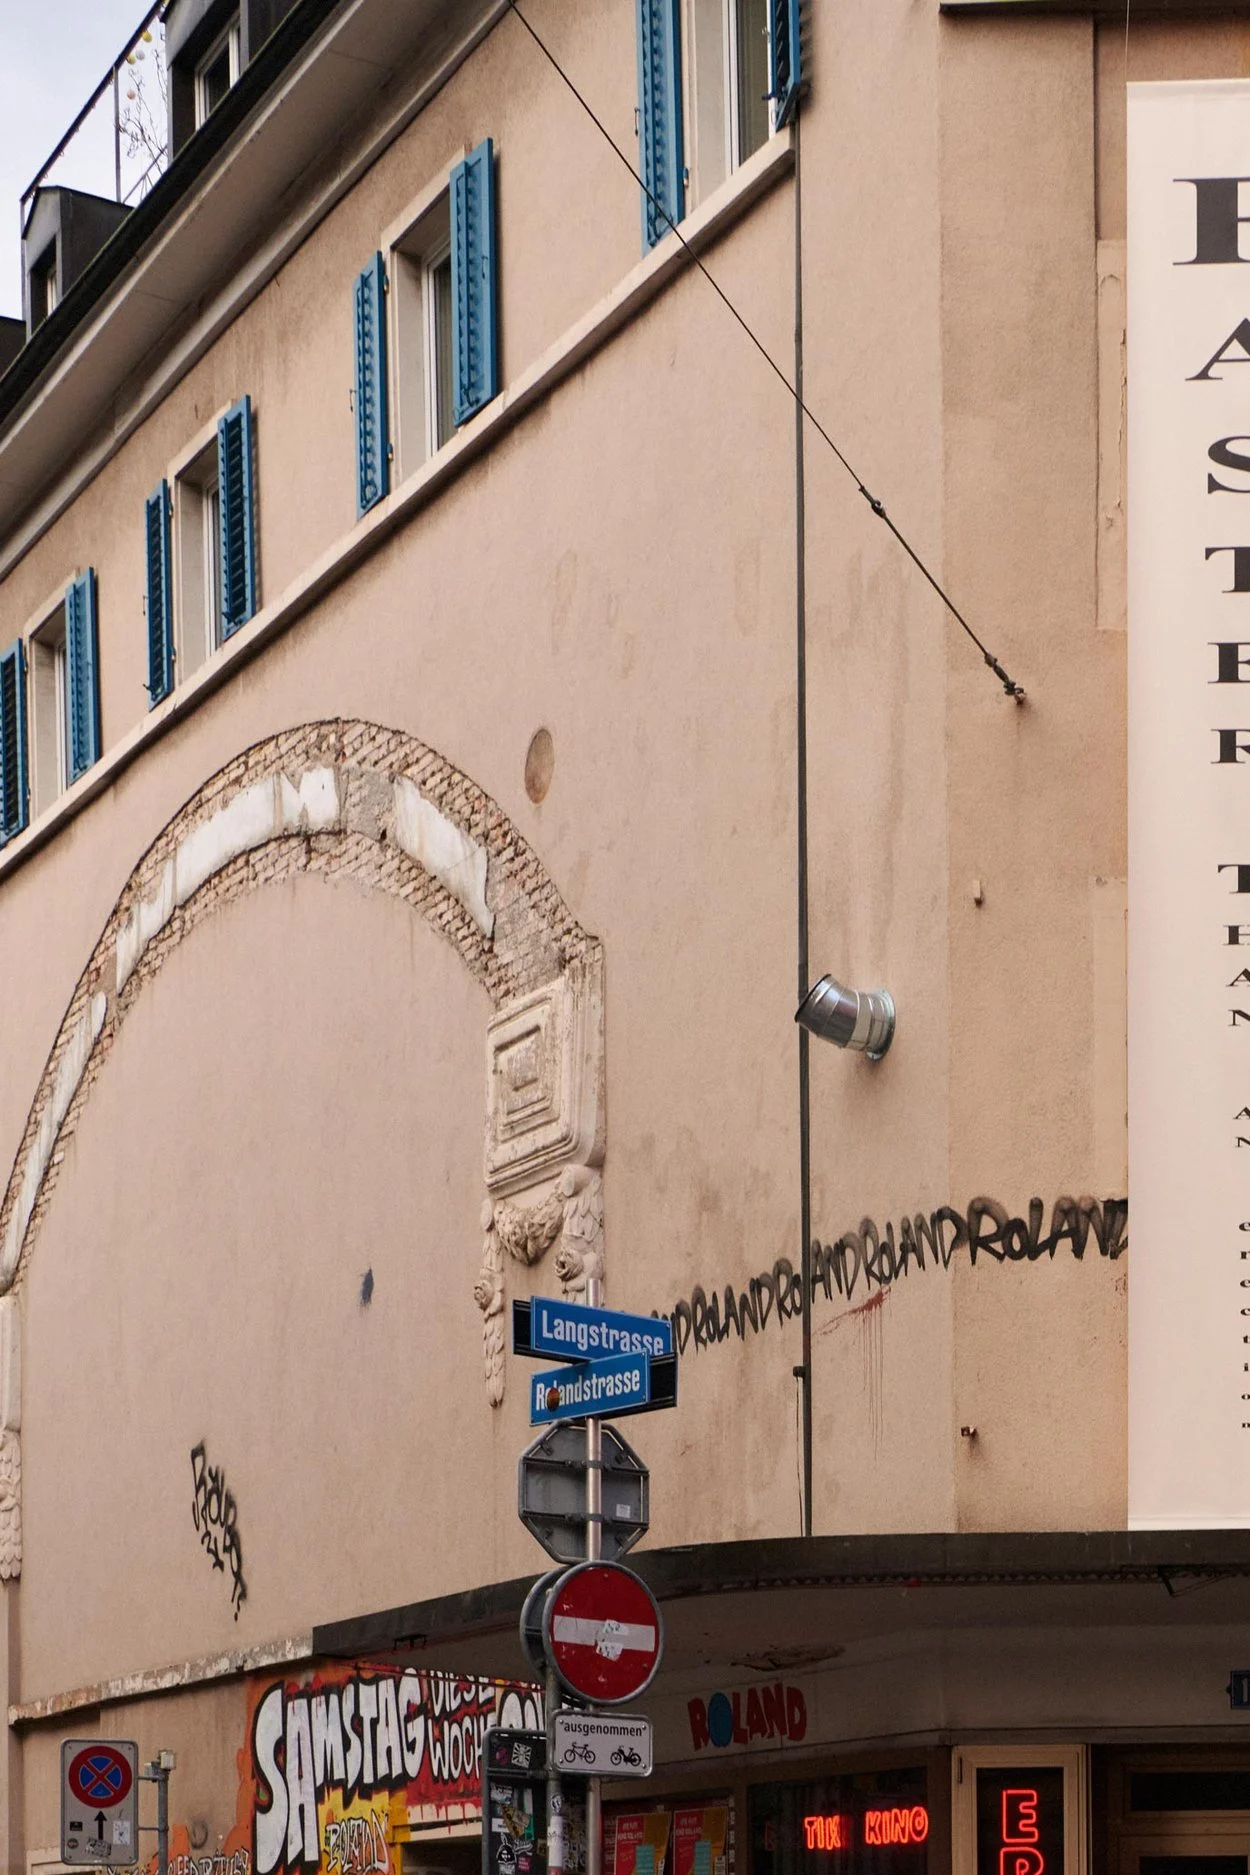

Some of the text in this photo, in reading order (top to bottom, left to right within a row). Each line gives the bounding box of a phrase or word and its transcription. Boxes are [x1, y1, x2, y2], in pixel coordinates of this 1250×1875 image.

[541, 1309, 664, 1355] Langstrasse
[535, 1368, 641, 1411] Randstrasse
[563, 1719, 643, 1738] ausgenommen
[687, 1683, 808, 1751] ROLAND
[255, 1667, 426, 1875] SAMSTAG
[865, 1806, 929, 1845] KINO
